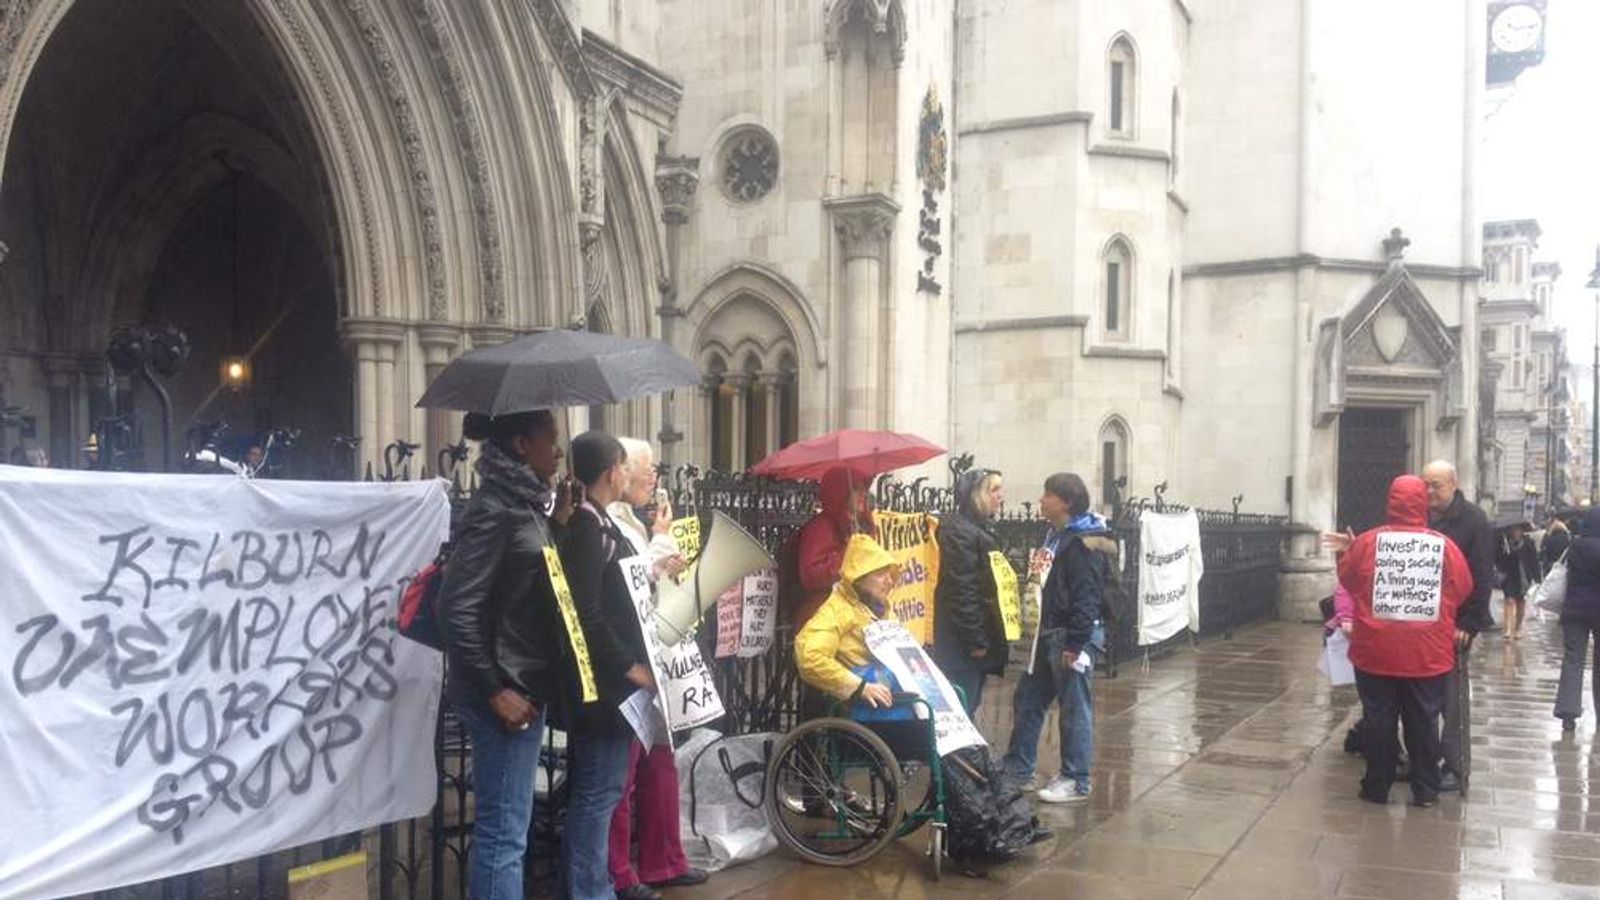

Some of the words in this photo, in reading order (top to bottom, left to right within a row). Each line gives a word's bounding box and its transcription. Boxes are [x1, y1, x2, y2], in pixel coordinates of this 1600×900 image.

[82, 522, 386, 607] KILBURN
[1376, 571, 1386, 586] A
[1377, 536, 1419, 553] Invest
[1419, 539, 1430, 553] in
[1432, 545, 1441, 553] a
[111, 638, 398, 768] WORKERS
[137, 714, 362, 846] GROUP
